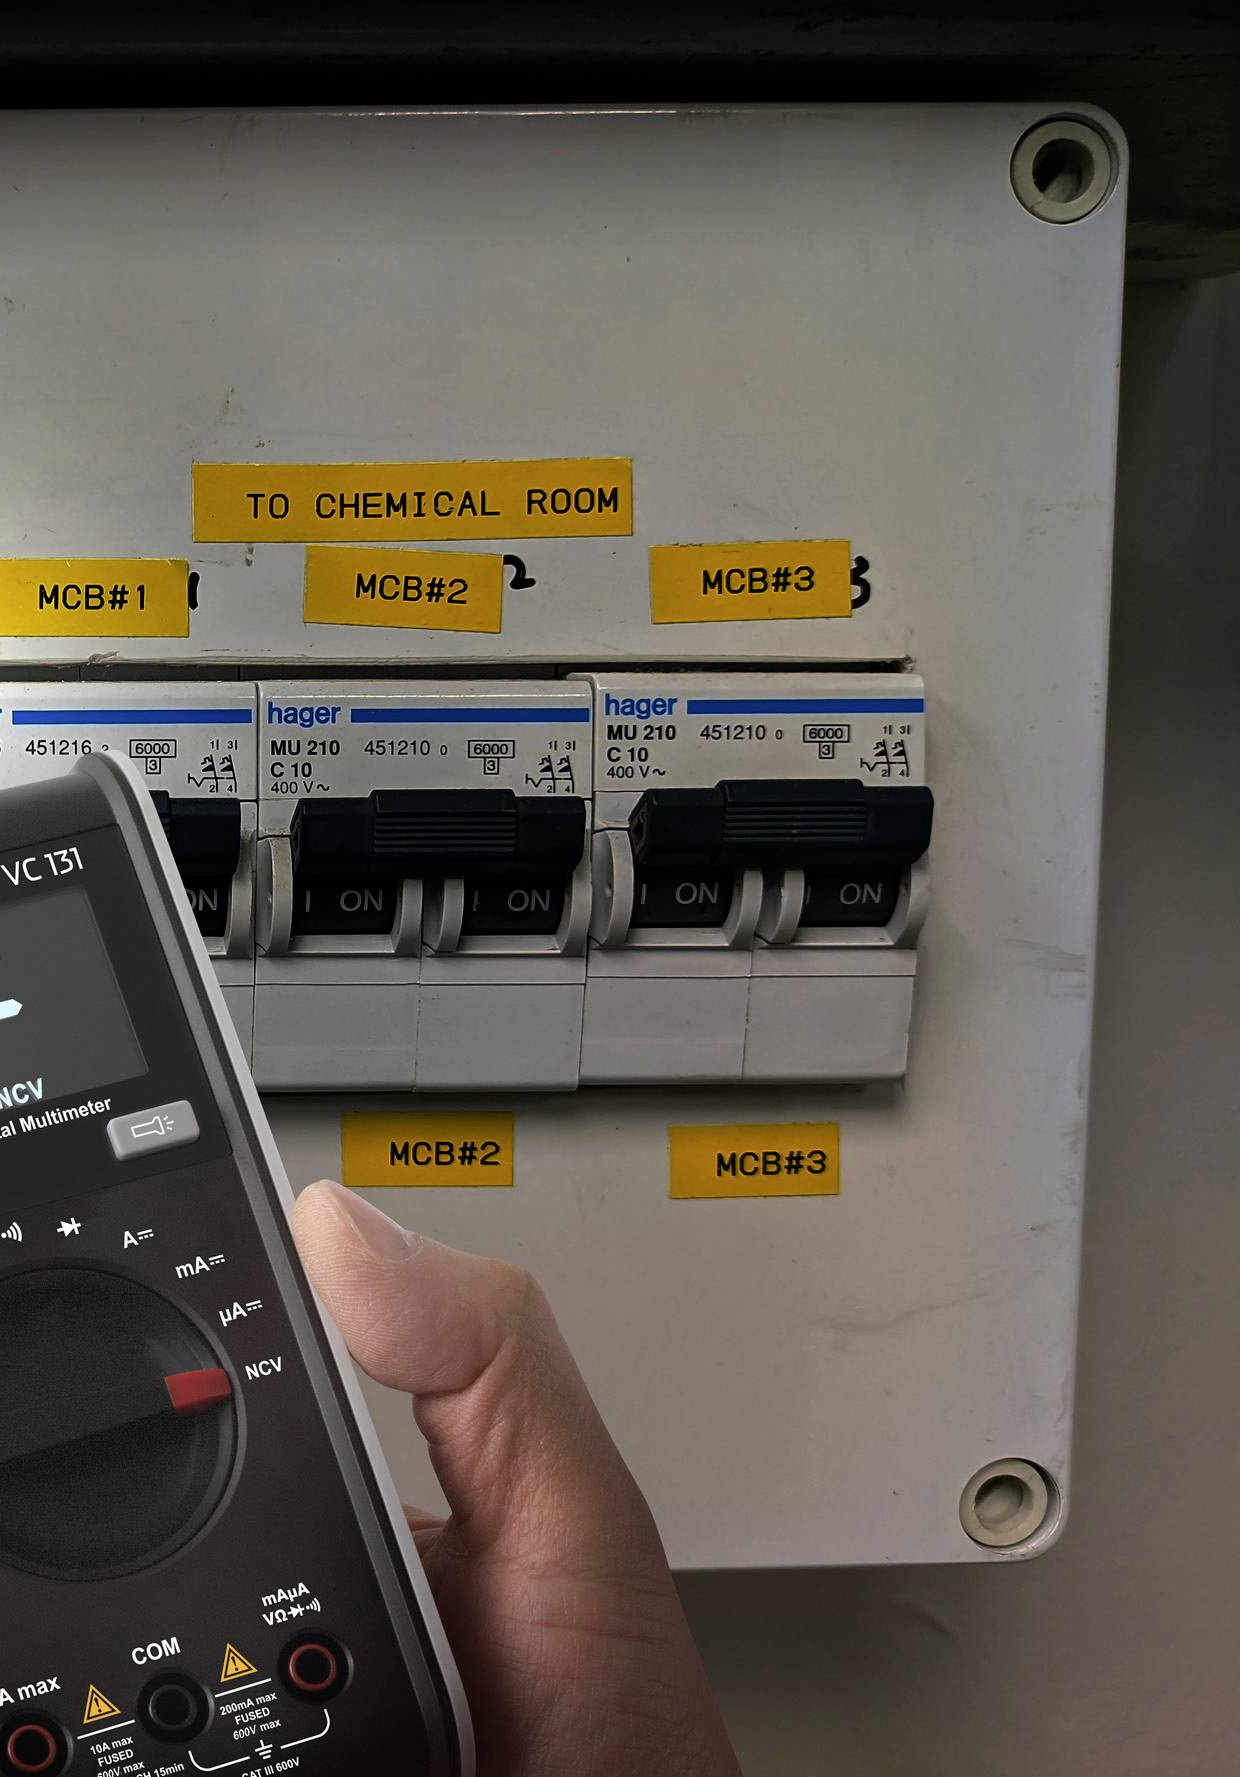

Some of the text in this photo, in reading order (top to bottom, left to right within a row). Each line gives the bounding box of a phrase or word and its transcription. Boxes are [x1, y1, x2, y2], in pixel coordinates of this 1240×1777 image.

[246, 487, 619, 519] TO CHEMICAL ROOM
[355, 573, 469, 605] MCB#2
[701, 565, 816, 596] MCB#3
[38, 583, 147, 611] MCB#1
[267, 702, 342, 728] hager
[605, 693, 678, 719] hager
[607, 724, 676, 740] MU 210
[700, 725, 766, 740] 451210
[808, 728, 843, 740] 6000
[25, 740, 92, 755] 451216
[135, 743, 170, 754] 6000
[270, 740, 340, 755] MU 210
[364, 740, 430, 755] 451210
[473, 743, 509, 755] 6000
[607, 747, 648, 762] C 10
[822, 745, 830, 756] 3
[149, 760, 157, 770] 3
[270, 762, 312, 778] C 10
[487, 760, 496, 771] 3
[606, 766, 634, 778] 400
[270, 781, 298, 794] 400
[0, 847, 84, 886] VC 131
[340, 890, 382, 912] ON
[507, 889, 550, 912] ON
[675, 882, 719, 905] ON
[840, 882, 882, 905] ON
[20, 1096, 113, 1132] Multimeter
[389, 1140, 500, 1166] MCB#2
[716, 1150, 827, 1177] MCB#3
[244, 1356, 283, 1380] NCV
[131, 1636, 181, 1665] COM
[17, 1676, 61, 1701] max
[219, 1692, 277, 1716] 200mA max
[234, 1707, 270, 1725] FUSED
[233, 1718, 281, 1740] 600V max
[90, 1736, 134, 1755] 10A max
[97, 1749, 134, 1767] FUSED
[276, 1757, 300, 1772] 600V
[123, 1761, 145, 1774] max
[153, 1763, 185, 1777] 15min
